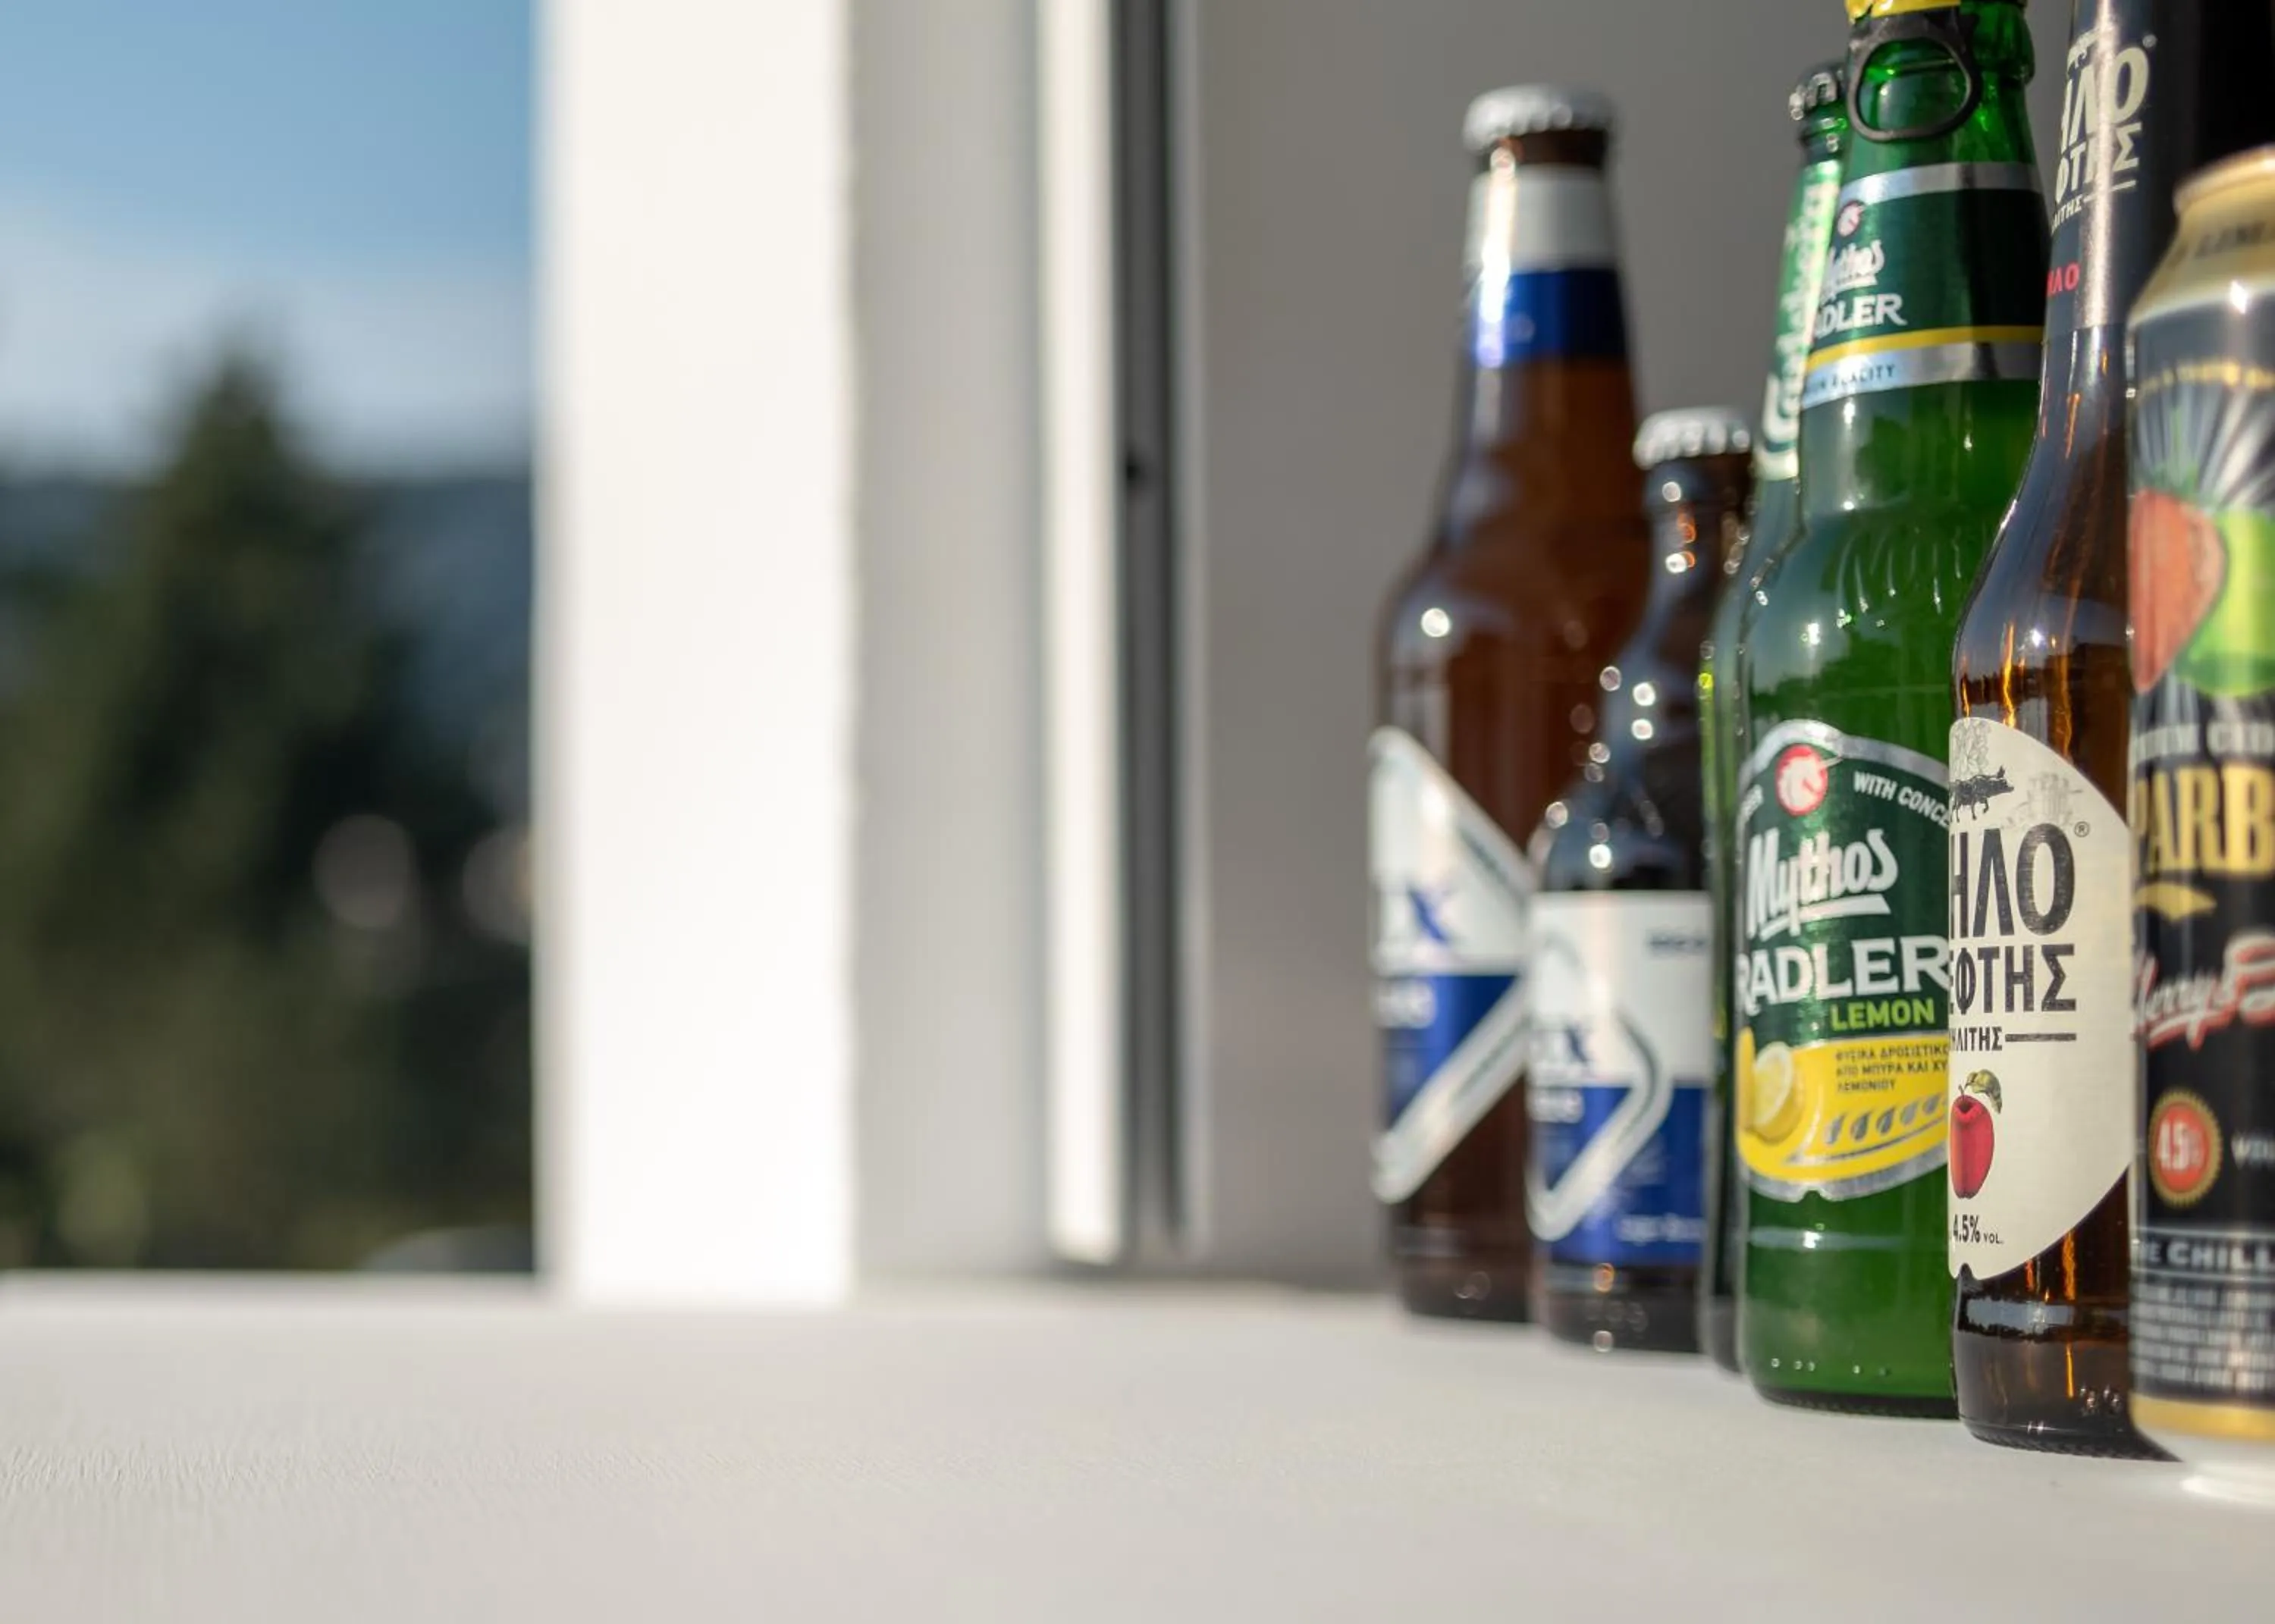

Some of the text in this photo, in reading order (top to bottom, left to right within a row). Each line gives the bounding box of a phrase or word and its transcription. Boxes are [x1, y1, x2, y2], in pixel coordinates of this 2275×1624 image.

[1853, 770, 1897, 801] WITH
[1746, 827, 1898, 941] Mythos
[1737, 936, 1949, 1016] RADLER
[1830, 998, 1935, 1032] LEMON
